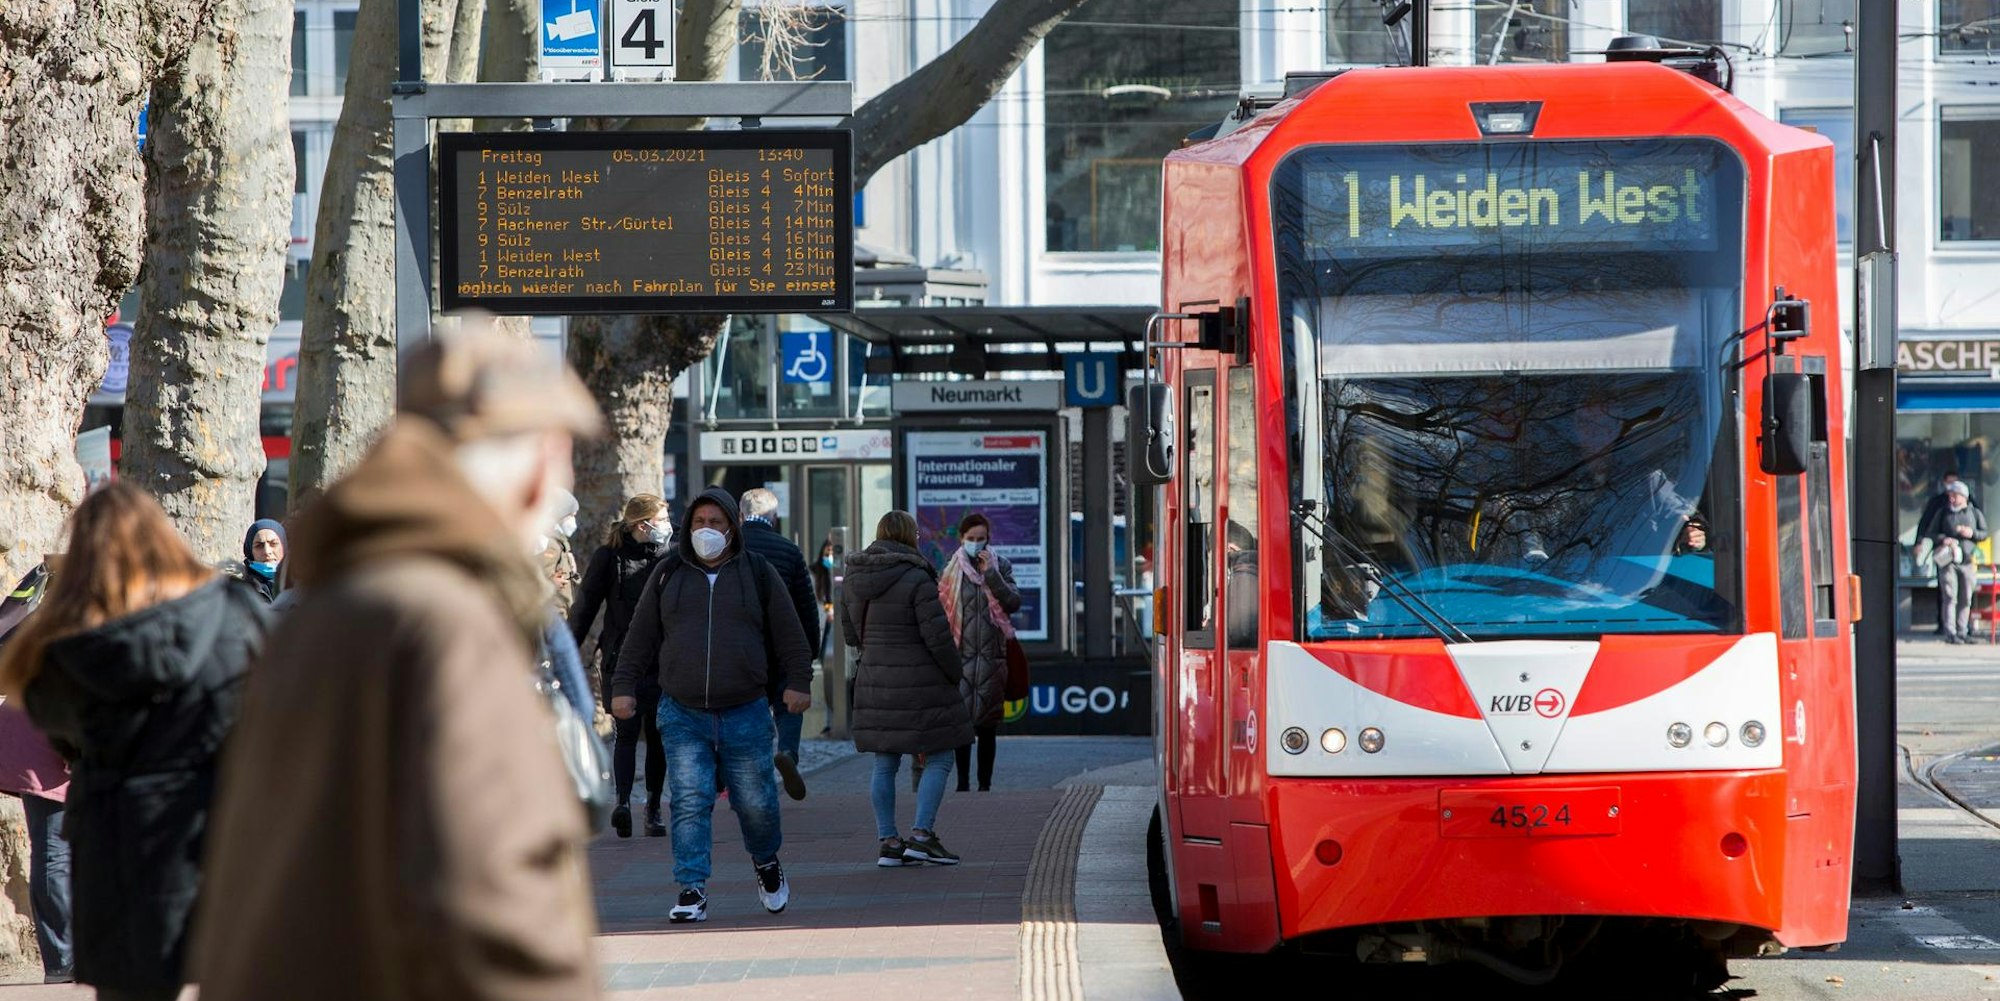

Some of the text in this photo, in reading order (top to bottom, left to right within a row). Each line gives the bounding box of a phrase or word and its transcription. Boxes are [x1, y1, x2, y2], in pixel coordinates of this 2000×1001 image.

[621, 9, 664, 59] 4
[481, 149, 803, 166] Freitag 05.03.2021 13:40
[479, 168, 834, 185] 1 Weiden West Gleis 4 Sofort
[478, 187, 487, 199] 7
[497, 187, 583, 199] Benzelrath
[708, 185, 750, 198] Gleis
[760, 184, 771, 197] 4
[477, 202, 488, 215] 9
[497, 202, 531, 215] Sülz
[708, 200, 750, 214] Gleis
[761, 200, 771, 213] 4
[1344, 169, 1701, 237] 1 Weiden West
[478, 218, 488, 231] 7
[497, 218, 569, 231] Aachener
[581, 216, 673, 230] Str./Gürtel
[709, 216, 750, 229] Gleis
[761, 216, 771, 229] 4
[478, 234, 488, 246] 9
[498, 233, 531, 246] Sülz
[709, 232, 750, 245] Gleis
[762, 231, 771, 244] 4
[480, 250, 488, 262] 1
[498, 250, 552, 262] Weiden
[563, 249, 601, 262] West
[709, 247, 751, 260] Gleis
[762, 247, 772, 260] 4
[479, 265, 488, 278] 7
[498, 265, 584, 278] Benzelrath
[710, 263, 751, 276] Gleis
[762, 263, 772, 276] 4
[522, 281, 574, 294] wieder
[586, 280, 622, 293] nach
[633, 279, 703, 296] Fahrplan
[714, 279, 738, 295] für
[750, 279, 776, 293] Sie
[785, 278, 836, 292] einset
[1076, 360, 1106, 399] U
[931, 386, 1022, 404] Neumarkt
[746, 438, 755, 451] 3
[763, 438, 774, 451] 4
[783, 438, 797, 452] 16
[917, 459, 1017, 473] Internationaler
[917, 472, 985, 487] Frauentag
[1490, 695, 1532, 713] KVB
[1489, 804, 1571, 829] 4524
